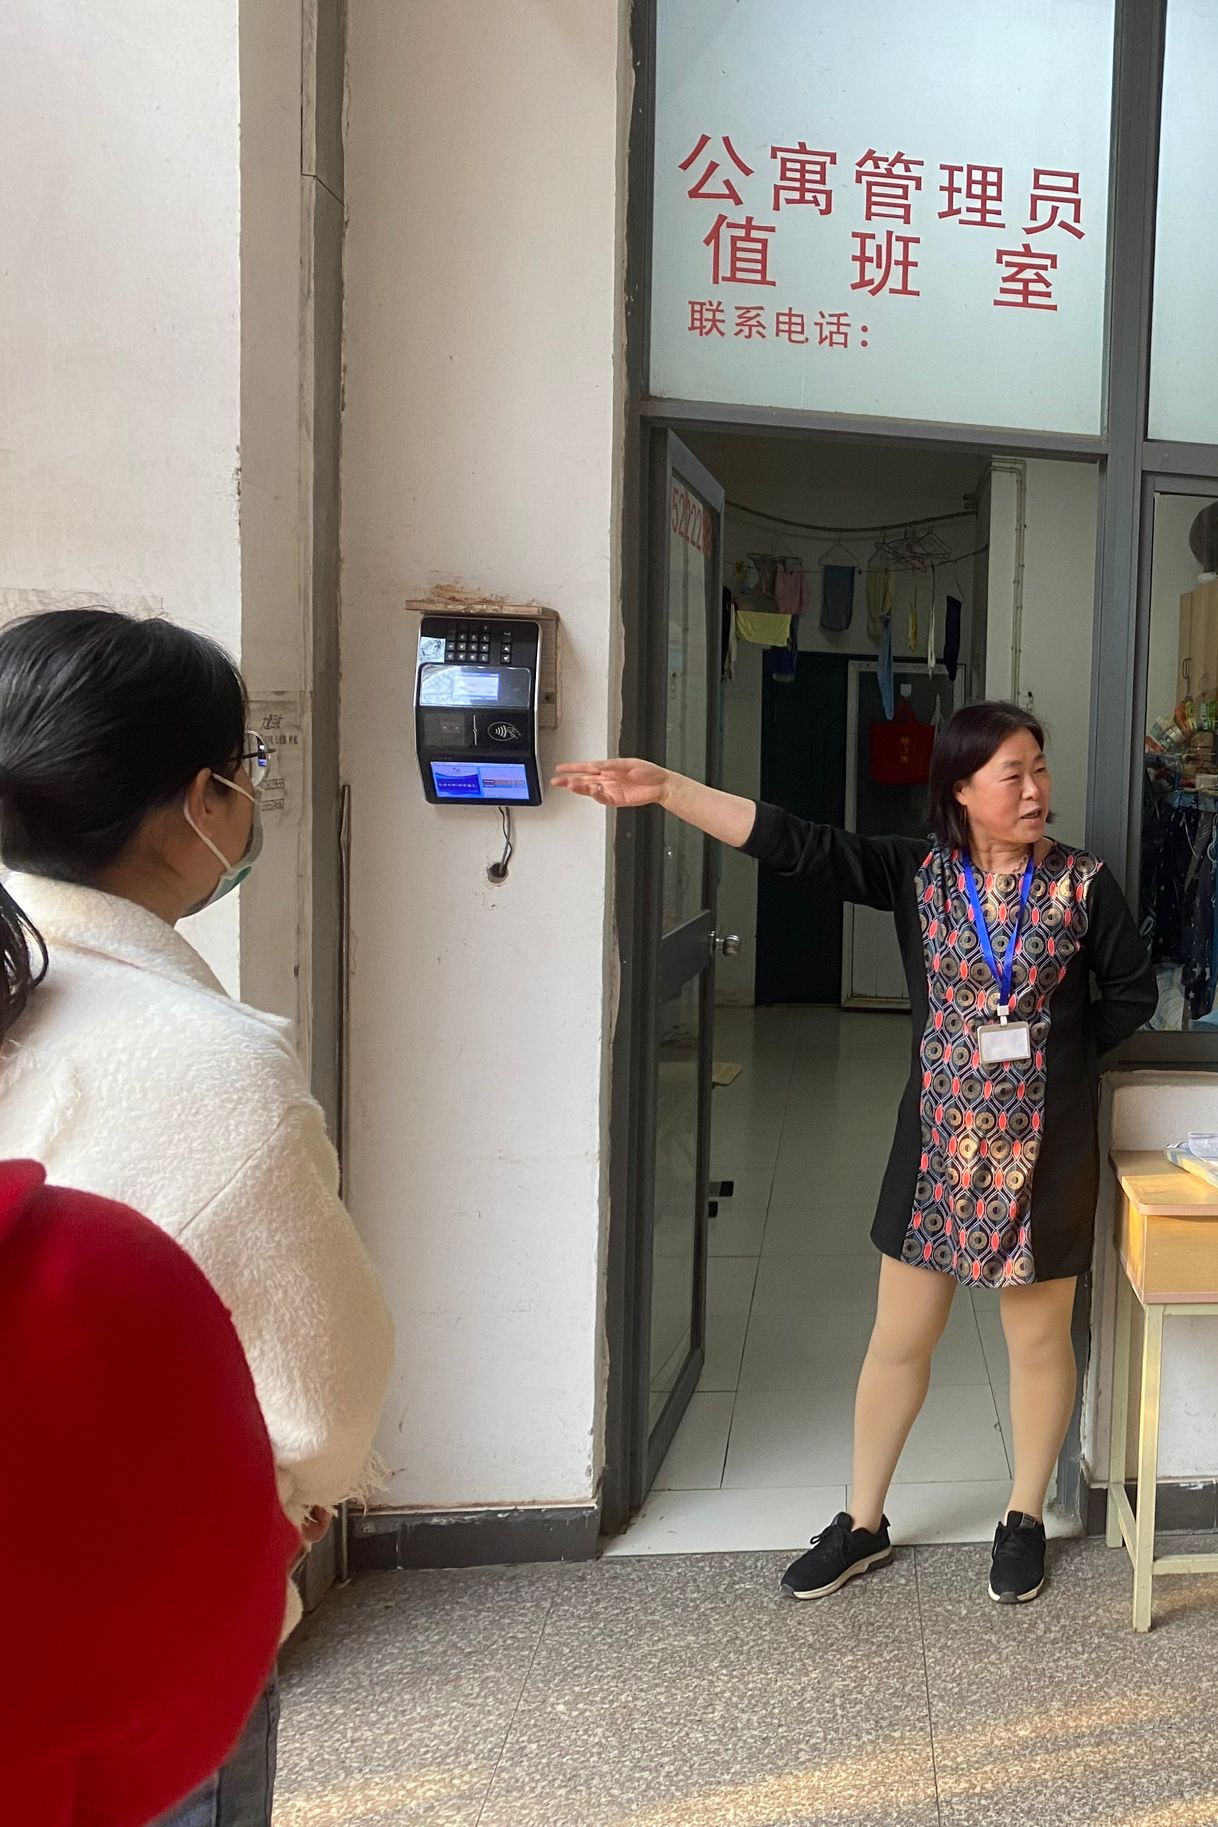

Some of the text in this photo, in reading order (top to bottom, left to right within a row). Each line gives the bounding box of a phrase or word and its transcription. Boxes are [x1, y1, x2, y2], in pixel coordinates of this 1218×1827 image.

[678, 134, 1085, 240] 公寓管理员
[687, 300, 868, 348] 联系电话：
